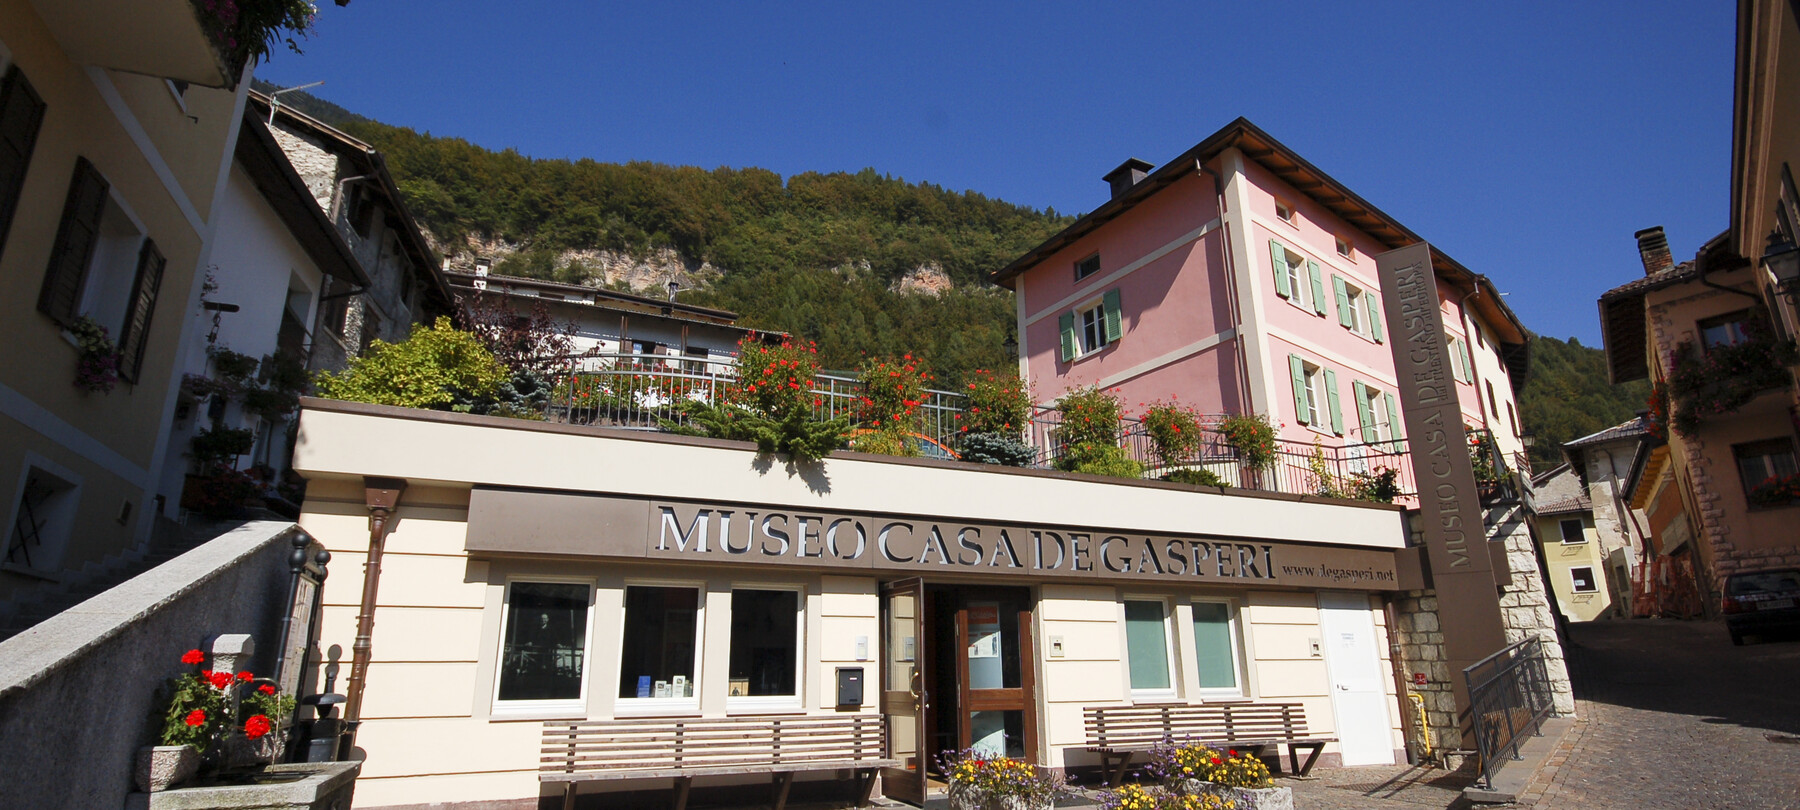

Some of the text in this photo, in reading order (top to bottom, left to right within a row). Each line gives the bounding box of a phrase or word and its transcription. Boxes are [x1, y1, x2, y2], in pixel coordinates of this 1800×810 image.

[1423, 323, 1444, 384] TRENTINO
[1395, 265, 1471, 570] MUSEO CASA DE GASPERI
[1436, 386, 1448, 401] dal
[656, 506, 1394, 584] MUSEO CASA DE GASPERI www.degasperi.net
